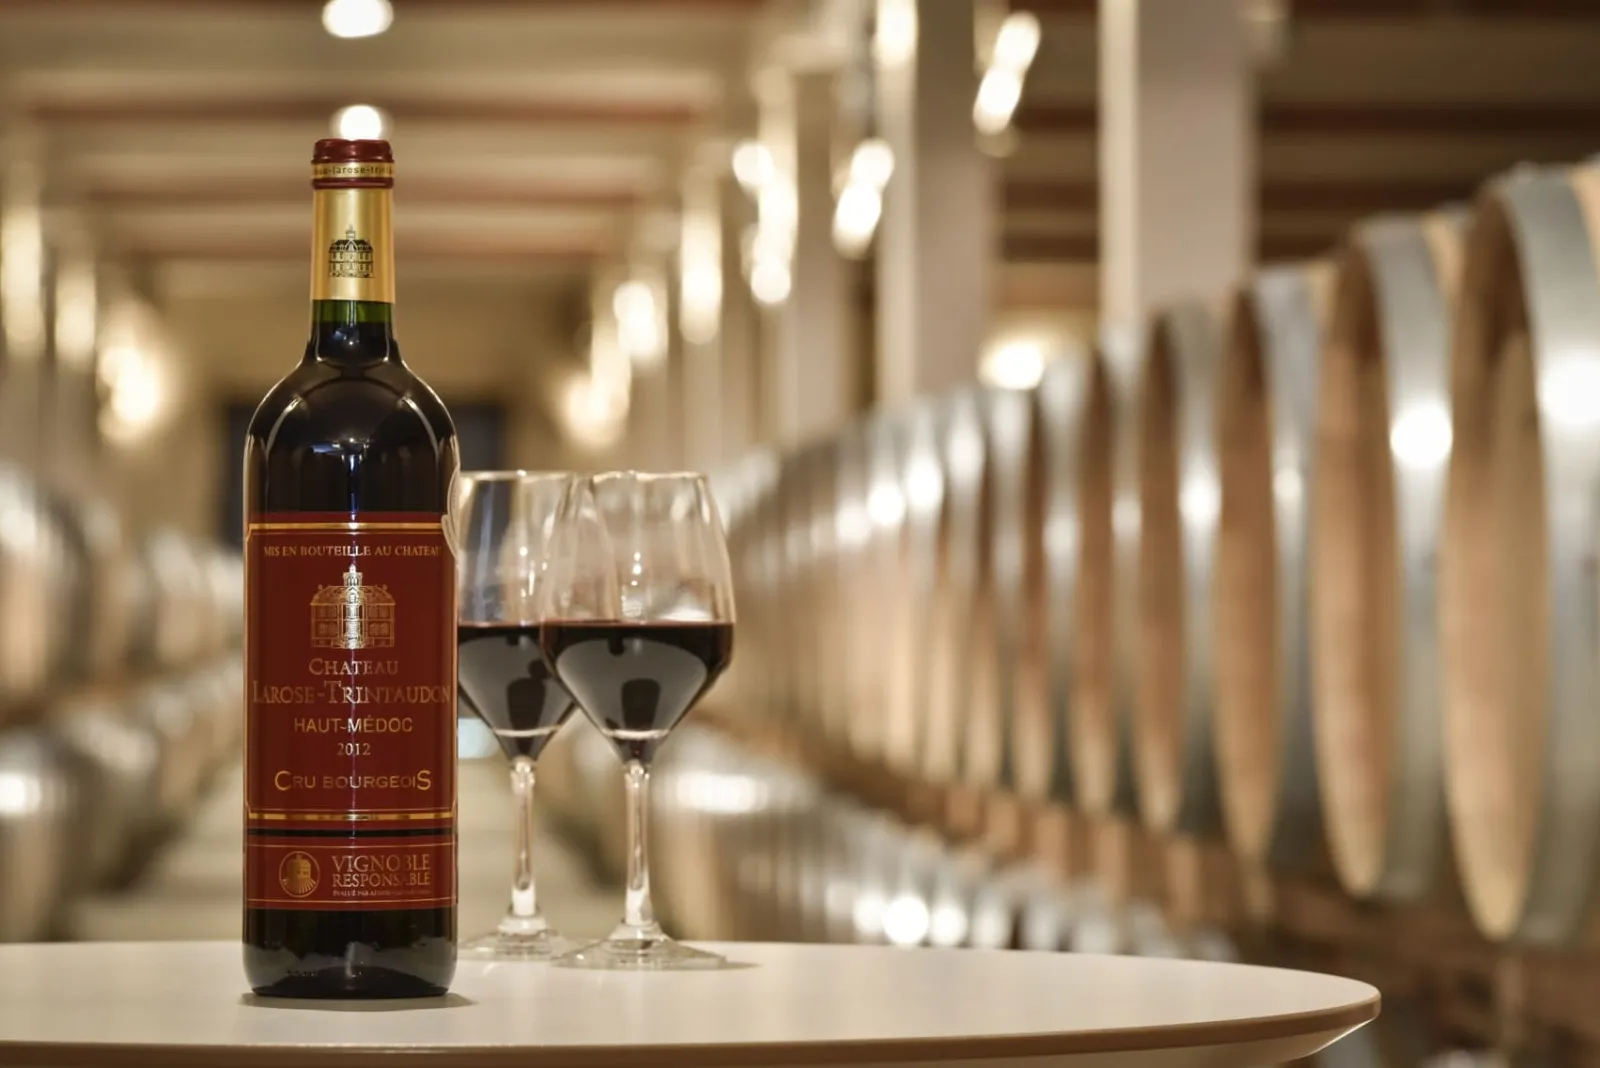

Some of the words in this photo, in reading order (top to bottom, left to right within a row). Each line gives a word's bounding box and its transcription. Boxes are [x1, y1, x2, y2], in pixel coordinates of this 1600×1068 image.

[263, 546, 280, 557] MIS
[282, 546, 297, 557] EN
[300, 545, 372, 557] BOUTEILLE
[375, 546, 392, 557] AU
[308, 658, 399, 676] CHATEAU
[252, 680, 450, 705] LAROSE-TRINTAUDON
[293, 714, 413, 733] HAUT-MÉDOC
[337, 742, 371, 756] 2012
[274, 770, 316, 791] CRU
[323, 769, 432, 791] BOURGEOIS
